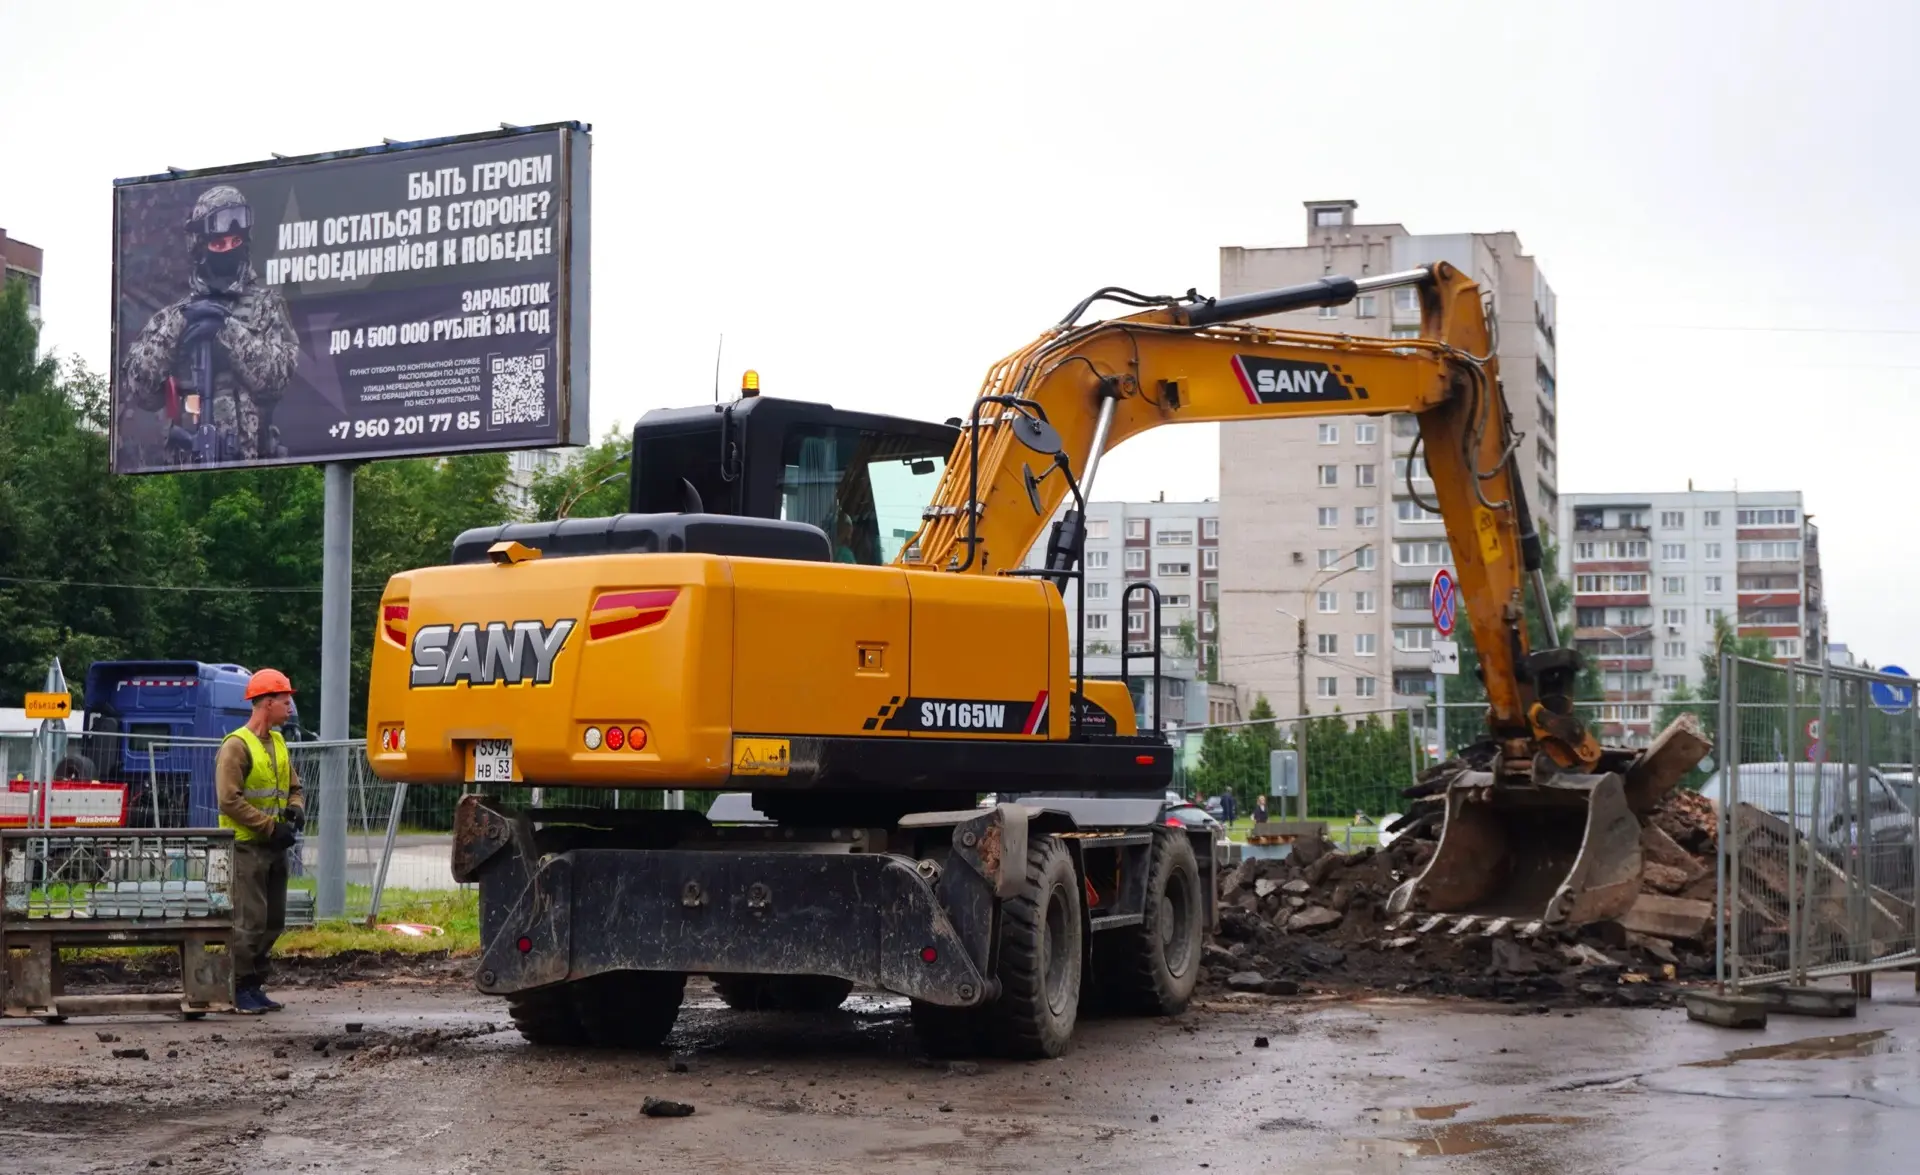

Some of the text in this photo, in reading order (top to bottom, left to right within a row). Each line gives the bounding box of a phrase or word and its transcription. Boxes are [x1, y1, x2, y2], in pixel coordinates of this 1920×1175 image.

[408, 154, 552, 200] БЫТЬ ГЕРОЕМ
[279, 190, 551, 250] ИЛИ ОСТАТЬСЯ В СТОРОНЕ?
[266, 227, 552, 285] ПРИСОЕДИНЯЙСЯ К ПОБЕДЕ!
[462, 282, 550, 312] ЗАРАБОТОК
[329, 308, 550, 354] ДО 4 500 000 РУБЛЕЙ ЗА ГОД
[350, 368, 370, 376] ПУНКТ
[371, 366, 396, 374] ОТБОРА
[407, 359, 454, 371] КОНТРАКТНОЙ
[454, 357, 481, 367] СЛУЖБЕ
[398, 370, 443, 380] РАСПОЛОЖЕН
[363, 384, 385, 393] УЛИЦА
[381, 390, 429, 400] ОБРАЩАЙТЕСЬ
[435, 385, 481, 395] ВОЕНКОМАТЫ
[1256, 369, 1328, 393] SANY
[415, 398, 436, 406] МЕСТУ
[329, 411, 480, 439] +7 960 201 77 85
[410, 618, 577, 688] SANY
[920, 702, 1005, 729] SY165W
[480, 740, 509, 756] 5394
[497, 760, 510, 774] 53
